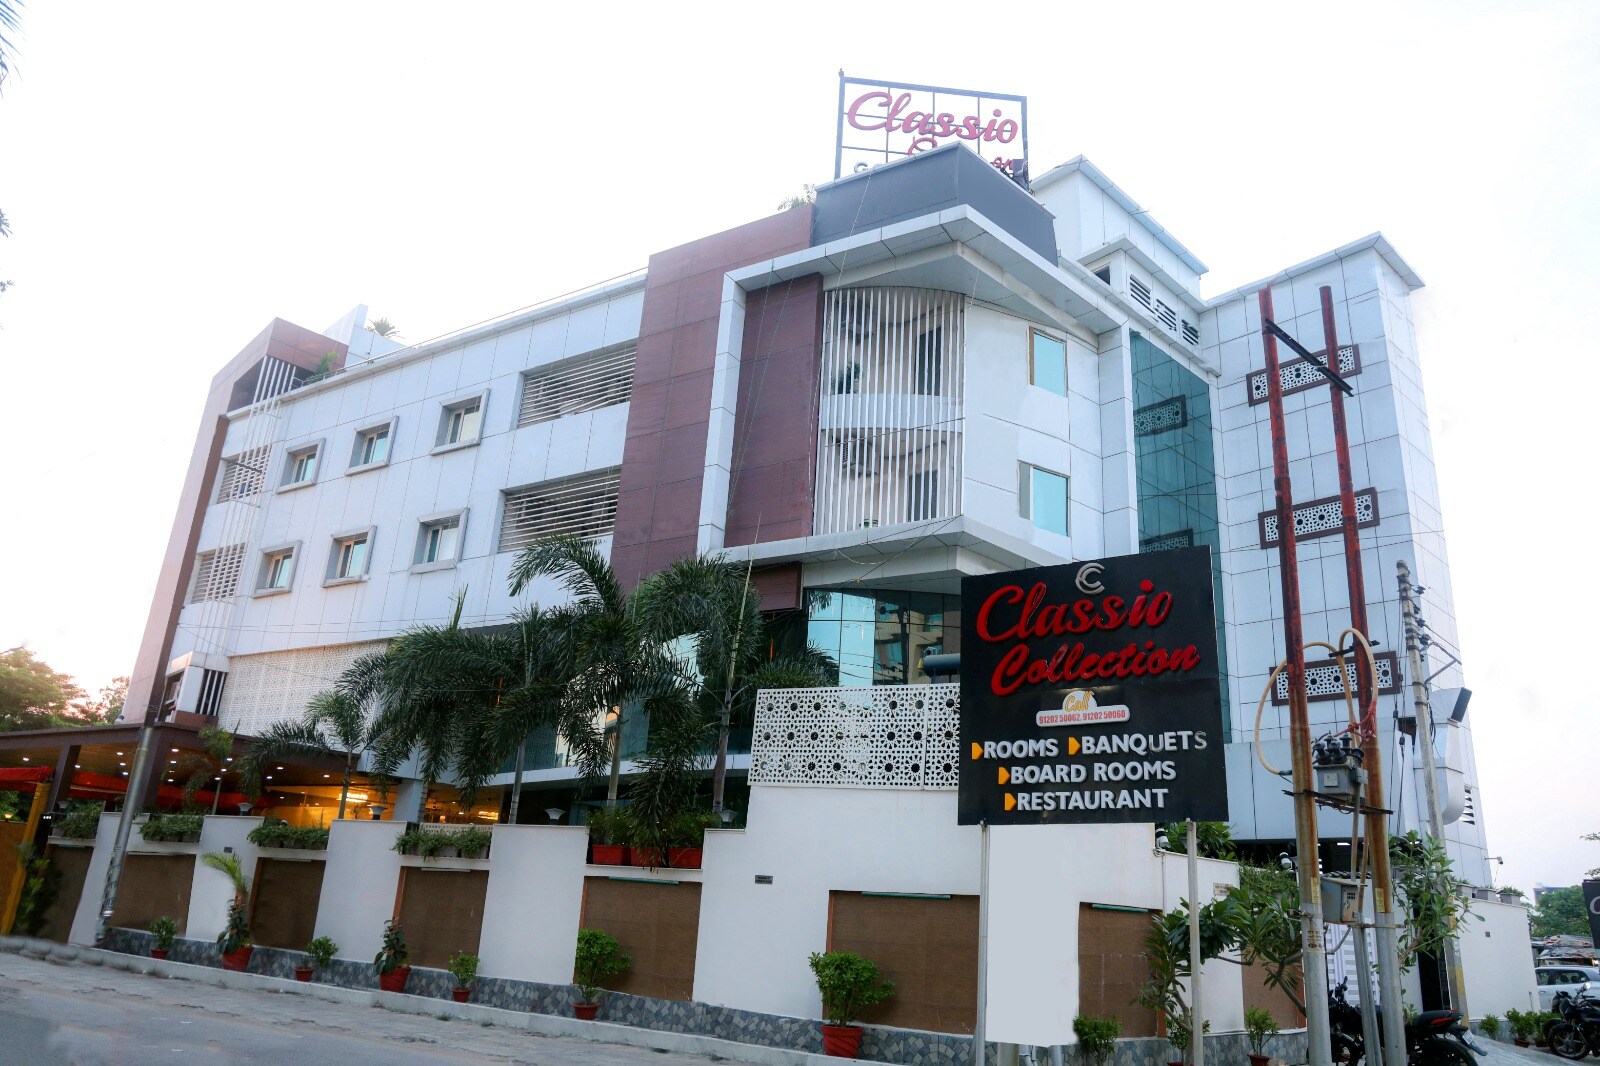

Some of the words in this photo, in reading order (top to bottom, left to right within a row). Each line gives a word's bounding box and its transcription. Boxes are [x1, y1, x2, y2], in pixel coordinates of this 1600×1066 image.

[847, 91, 1018, 143] Classio
[976, 579, 1173, 642] Classio
[991, 640, 1200, 696] Collection
[1065, 690, 1093, 712] Call
[1039, 715, 1058, 724] 91202
[1083, 711, 1102, 720] 91202
[1104, 710, 1125, 719] 50060
[984, 738, 1060, 759] ROOMS
[1081, 730, 1208, 756] BANQUETS
[1010, 764, 1087, 785] BOARD
[1093, 760, 1177, 782] ROOMS
[1017, 788, 1169, 812] RESTAURANT
